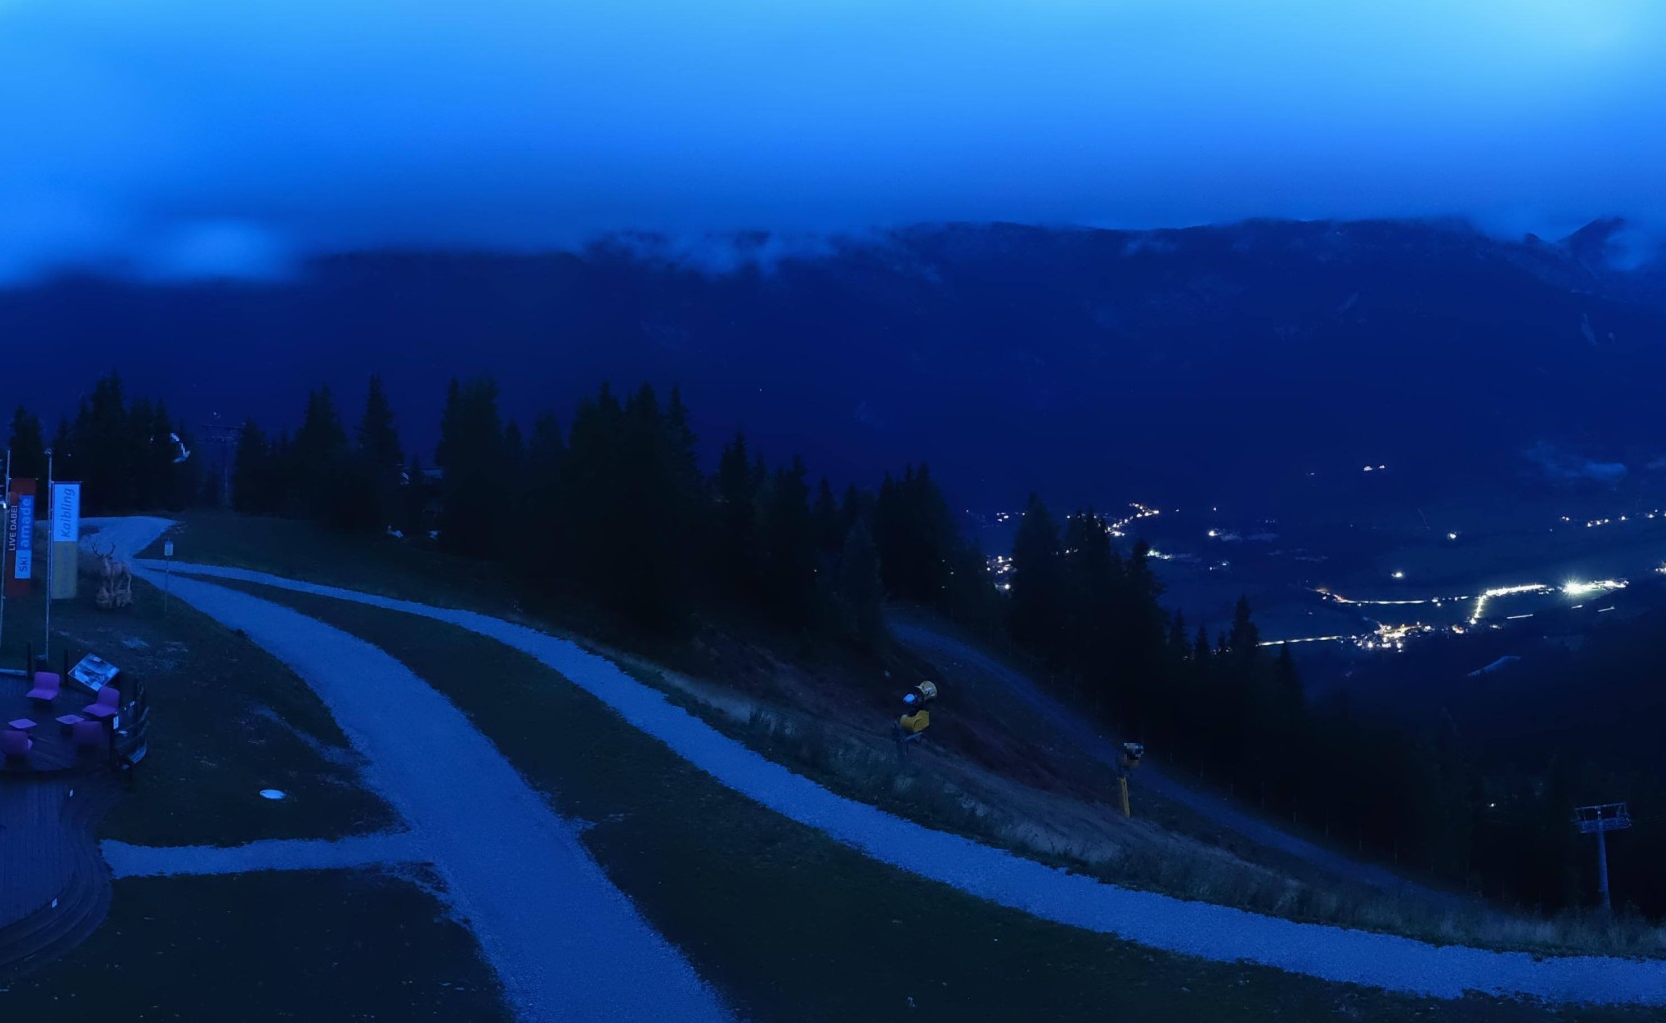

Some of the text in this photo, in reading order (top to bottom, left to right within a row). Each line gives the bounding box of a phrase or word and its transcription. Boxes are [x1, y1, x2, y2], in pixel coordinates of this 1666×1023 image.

[8, 505, 18, 551] LIVE DABEI
[61, 488, 76, 538] Kaibling
